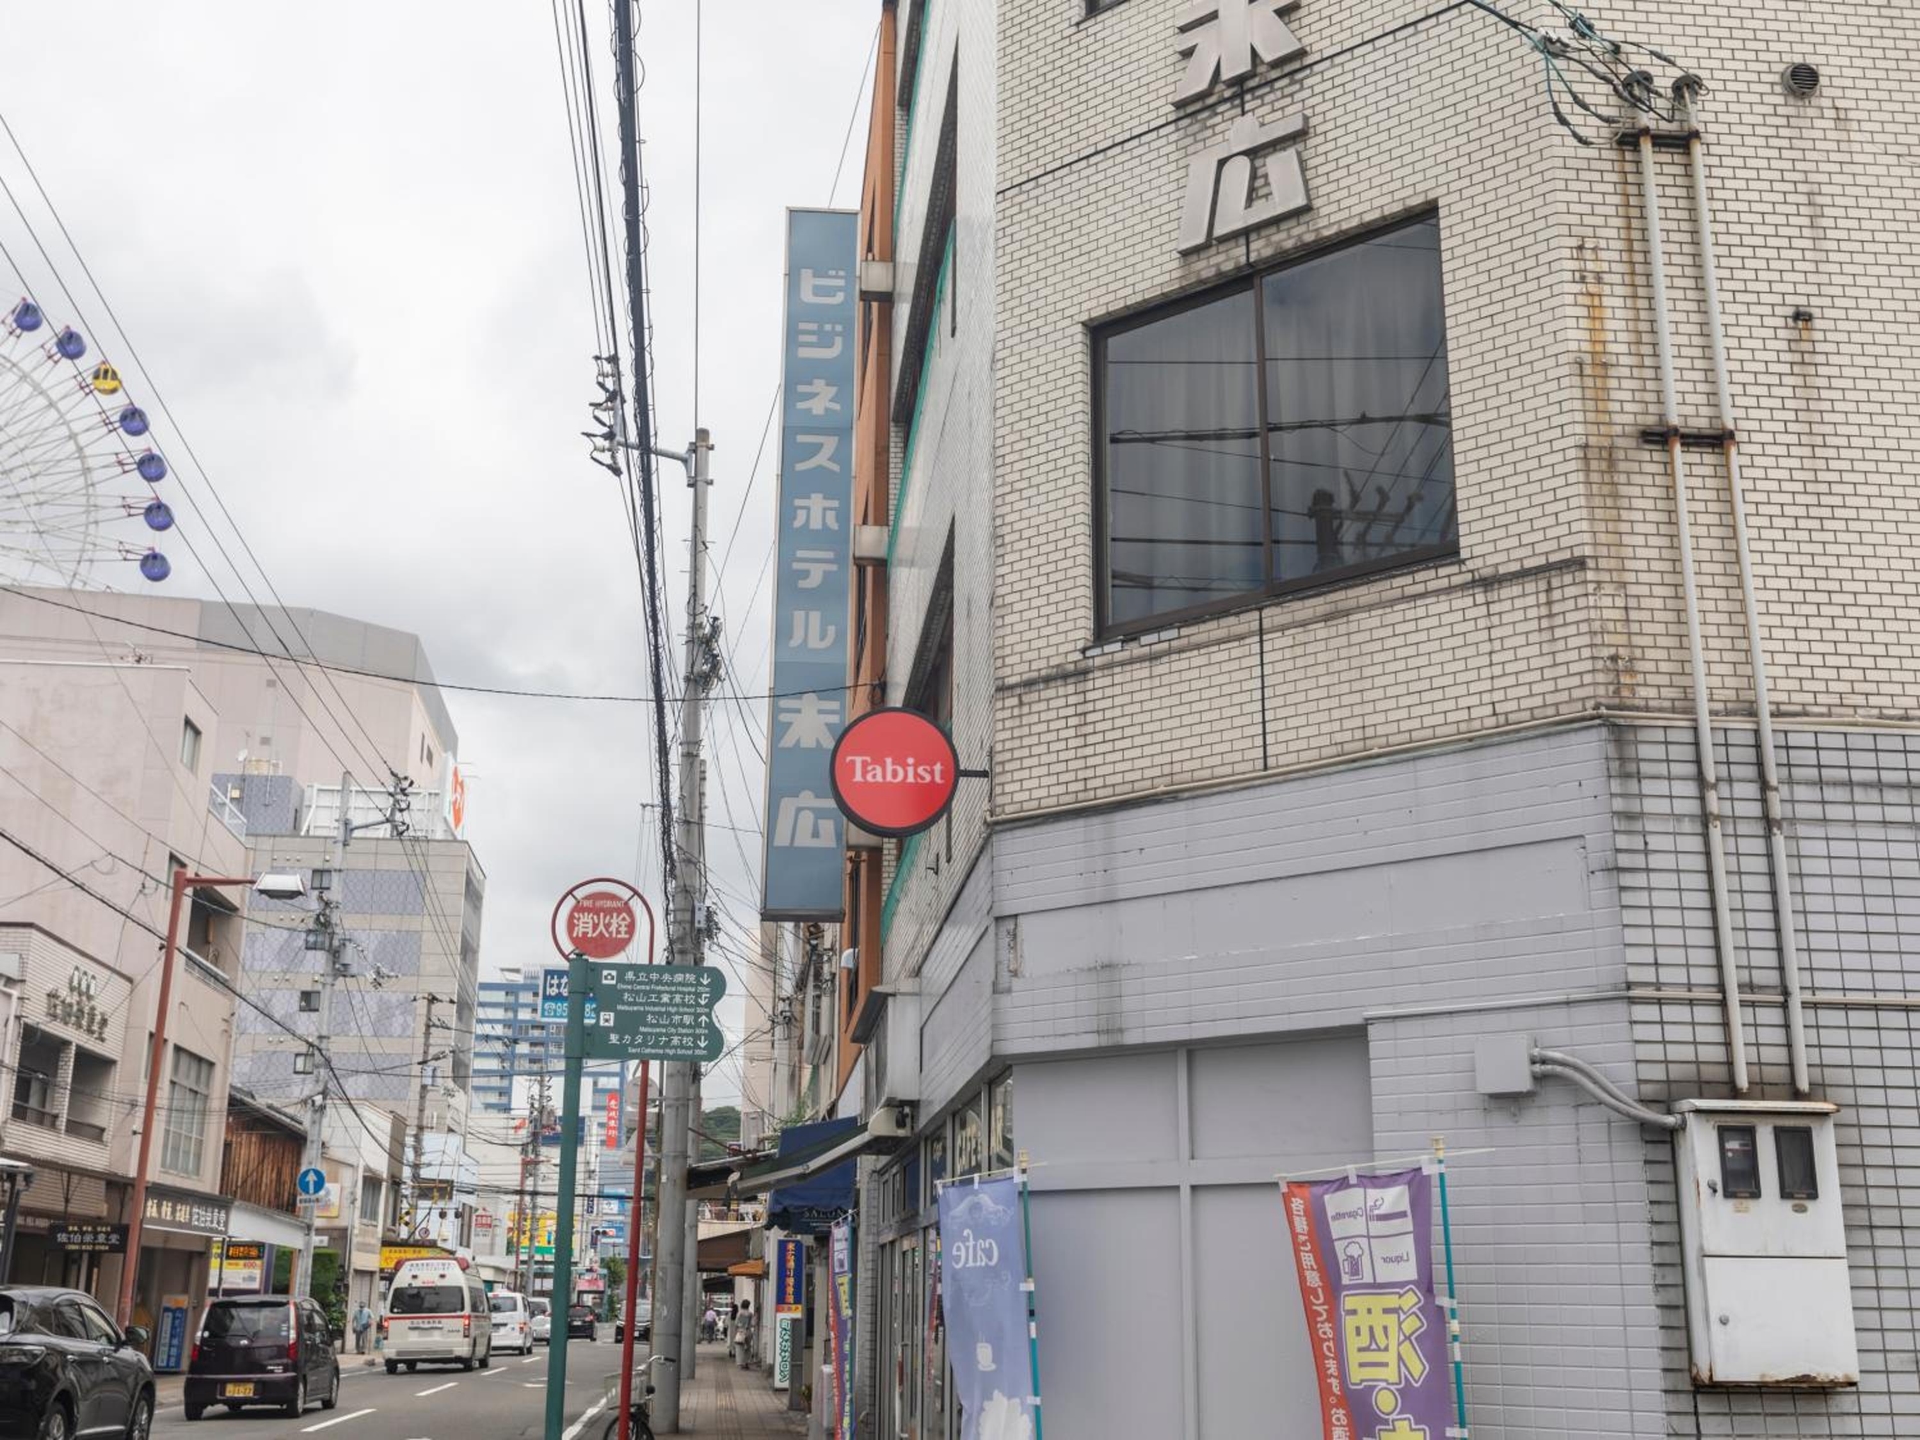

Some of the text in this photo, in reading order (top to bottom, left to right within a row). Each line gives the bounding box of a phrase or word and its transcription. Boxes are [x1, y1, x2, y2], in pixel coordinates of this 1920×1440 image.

[774, 268, 847, 849] ビジネスホテル 末広
[846, 755, 946, 784] Tabist
[572, 911, 631, 939] 消火栓
[624, 971, 697, 984] 県立中央病院
[623, 992, 696, 1005] 松山工業高校
[646, 1014, 695, 1025] 松山市駅
[608, 1033, 694, 1047] 聖カタリナ高校
